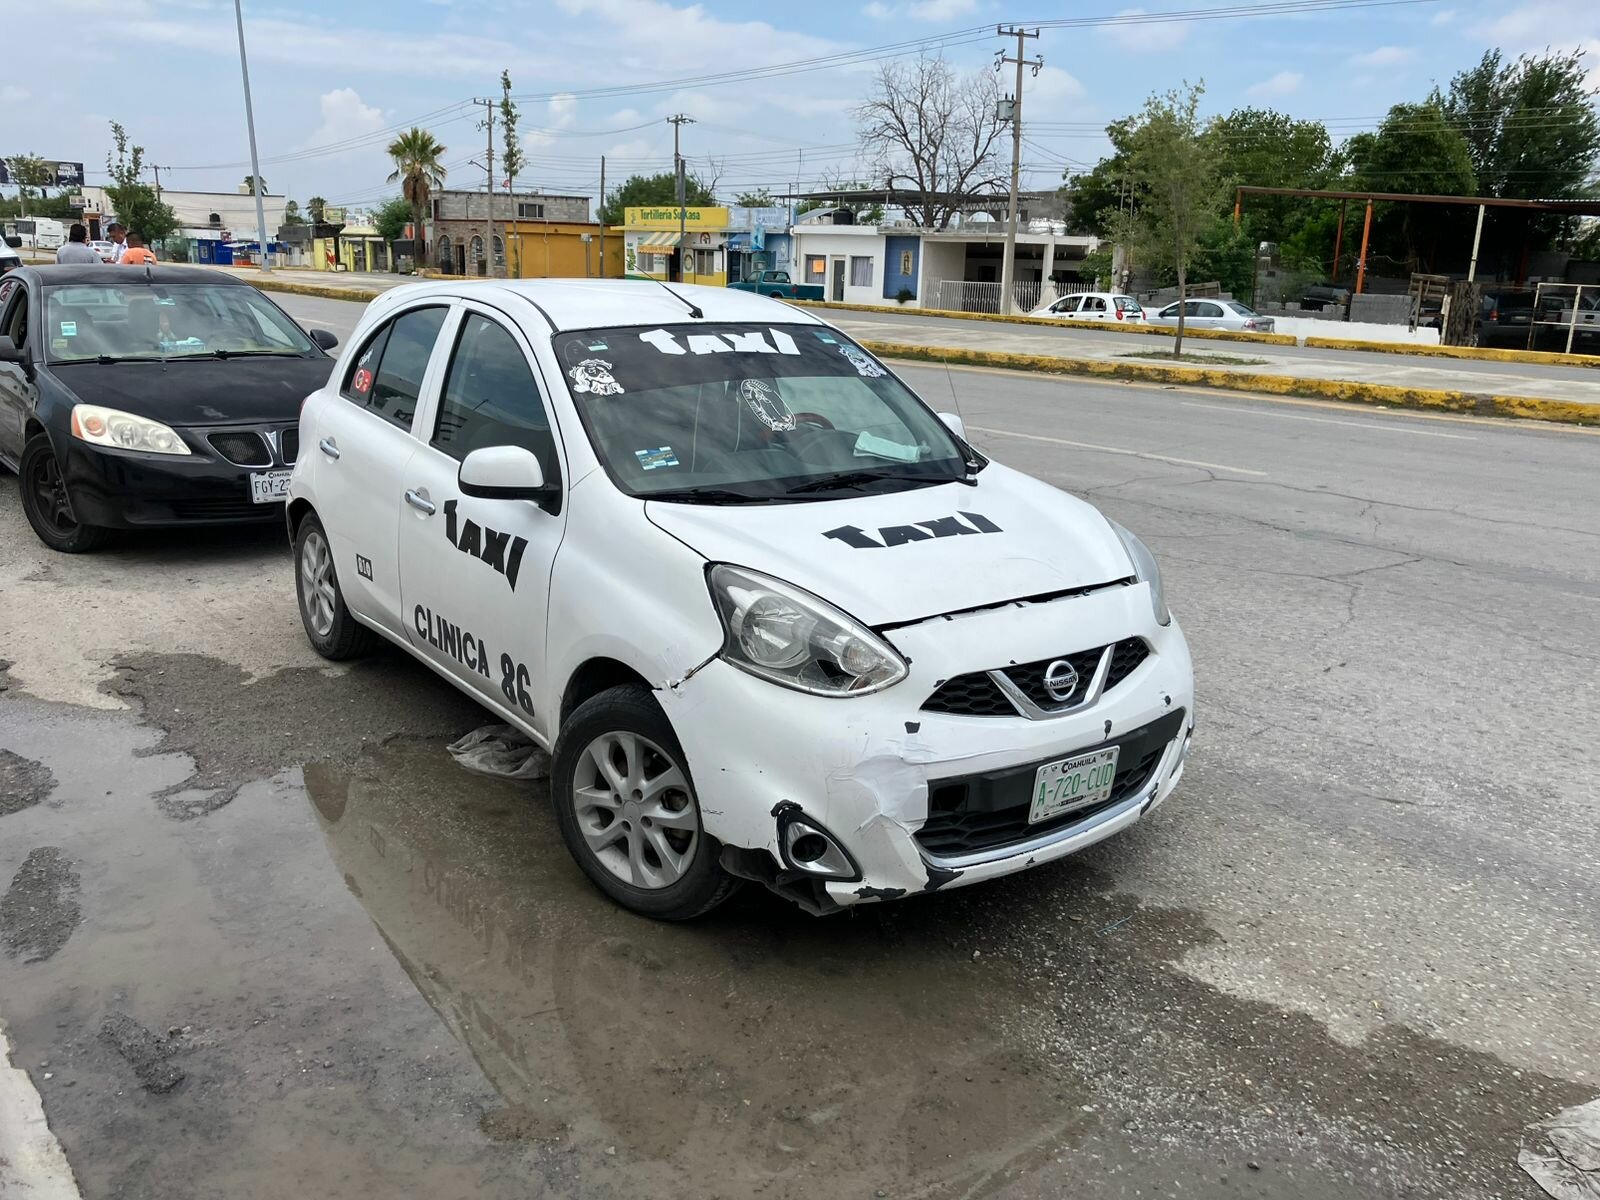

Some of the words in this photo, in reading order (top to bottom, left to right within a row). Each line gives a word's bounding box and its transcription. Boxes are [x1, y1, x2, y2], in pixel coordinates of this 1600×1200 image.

[639, 328, 800, 355] TAXI
[443, 499, 528, 592] TAXI
[820, 510, 1004, 549] TAXI
[414, 604, 490, 678] CLINICA
[500, 652, 535, 717] 86
[1050, 674, 1077, 687] NISSAN
[1037, 762, 1114, 807] A-720-CUD
